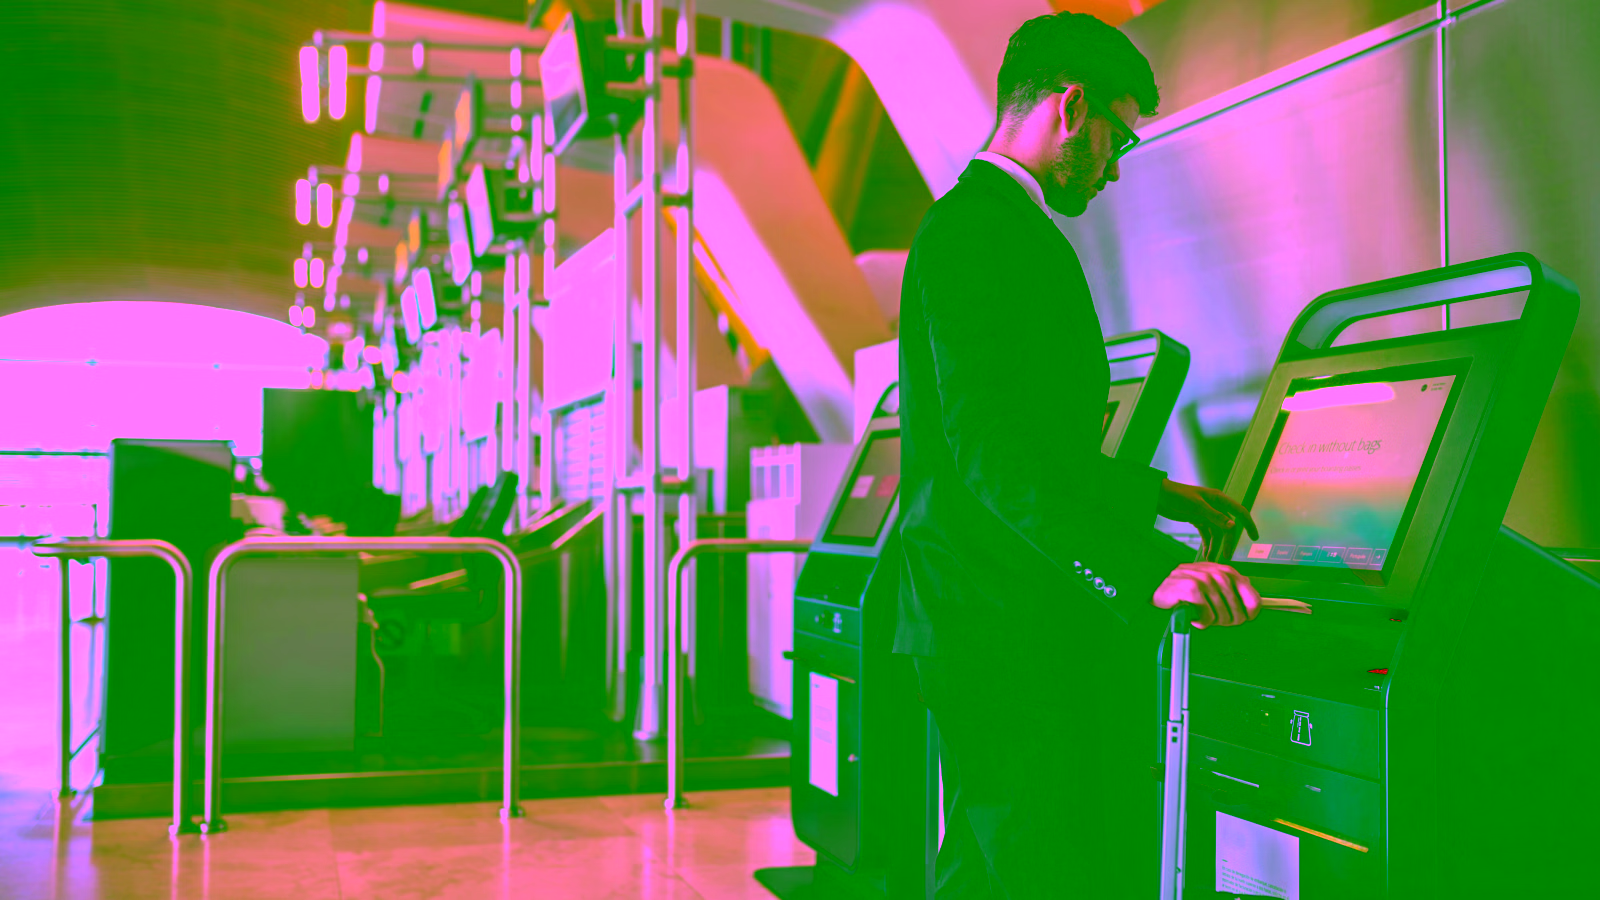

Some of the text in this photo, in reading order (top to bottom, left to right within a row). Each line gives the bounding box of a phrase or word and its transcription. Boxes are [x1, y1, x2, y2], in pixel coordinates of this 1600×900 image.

[1278, 438, 1382, 455] Check in without bags
